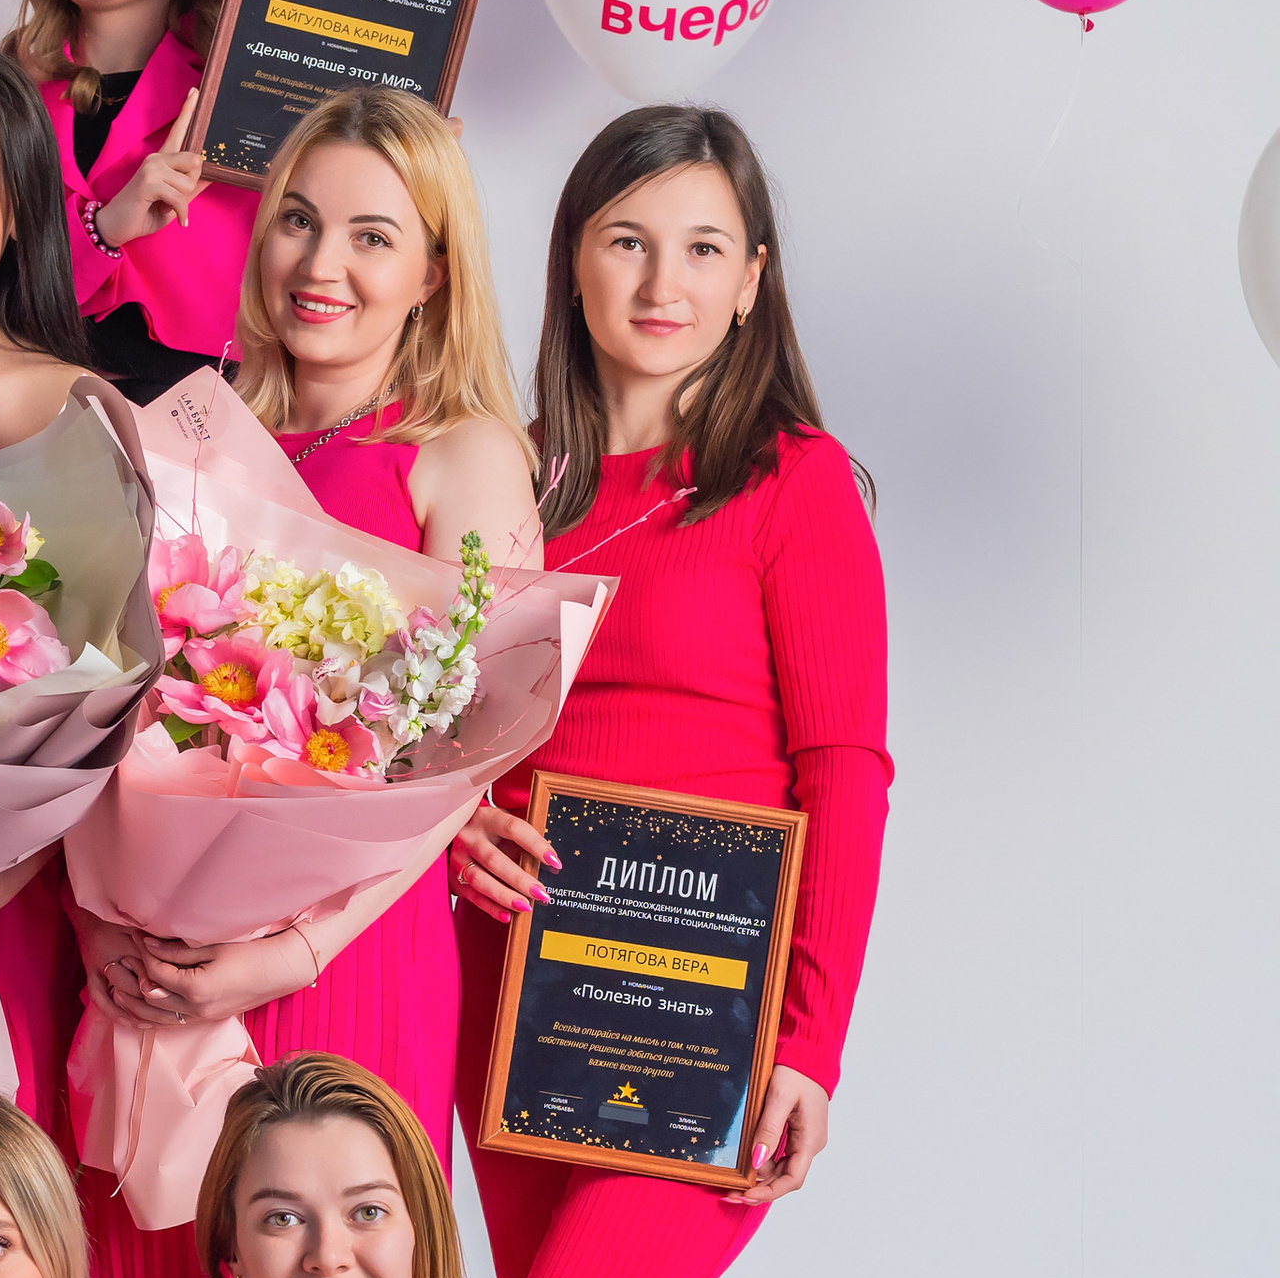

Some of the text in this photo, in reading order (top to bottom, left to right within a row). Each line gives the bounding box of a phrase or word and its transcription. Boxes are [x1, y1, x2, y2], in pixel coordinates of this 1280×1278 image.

[425, 4, 446, 14] СЕТЯХ
[270, 6, 406, 48] КАЙГУЛОВА КАРИНА
[246, 41, 422, 91] «Делаю краше этот МИР»
[596, 856, 718, 902] ДИПЛОМ
[556, 899, 616, 914] НАПРАВЛЕНИЮ
[617, 908, 652, 920] ЗАПУСКА
[653, 914, 672, 923] СЕБЯ
[673, 916, 679, 924] В
[680, 918, 735, 933] СОЦИАЛЬНЫХ
[736, 926, 760, 937] СЕТЯХ
[622, 898, 682, 914] ПРОХОЖДЕНИИ
[683, 908, 715, 919] МАСТЕР
[716, 913, 752, 926] МАЙНДА
[753, 918, 766, 927] 2.0
[585, 943, 709, 974] ПОТЯГОВА ВЕРА
[572, 983, 713, 1016] «Полезно знать»
